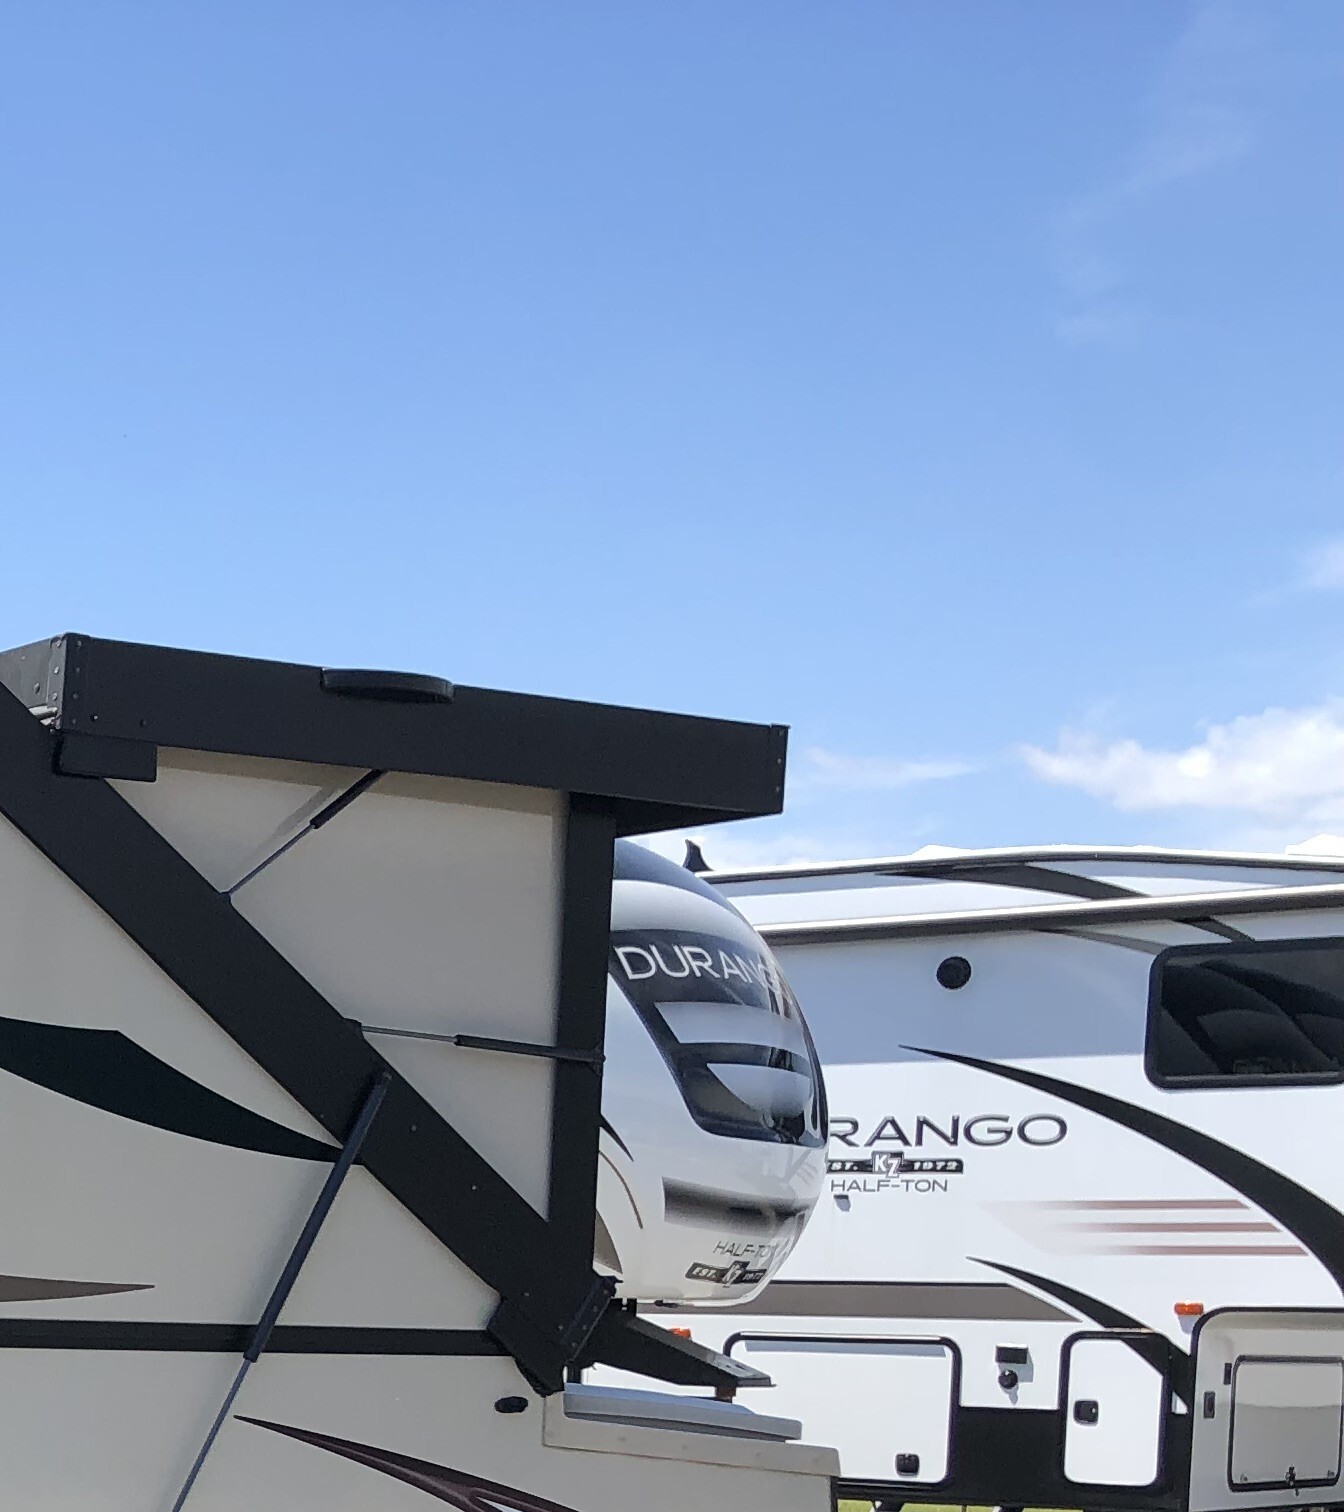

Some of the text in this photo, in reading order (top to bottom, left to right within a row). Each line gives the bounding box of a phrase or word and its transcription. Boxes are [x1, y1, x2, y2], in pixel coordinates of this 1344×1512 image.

[615, 944, 782, 992] DURANG
[827, 1153, 959, 1178] ST. KZ 1972
[830, 1179, 948, 1192] HALF-TON
[713, 1240, 779, 1258] HALF-TO
